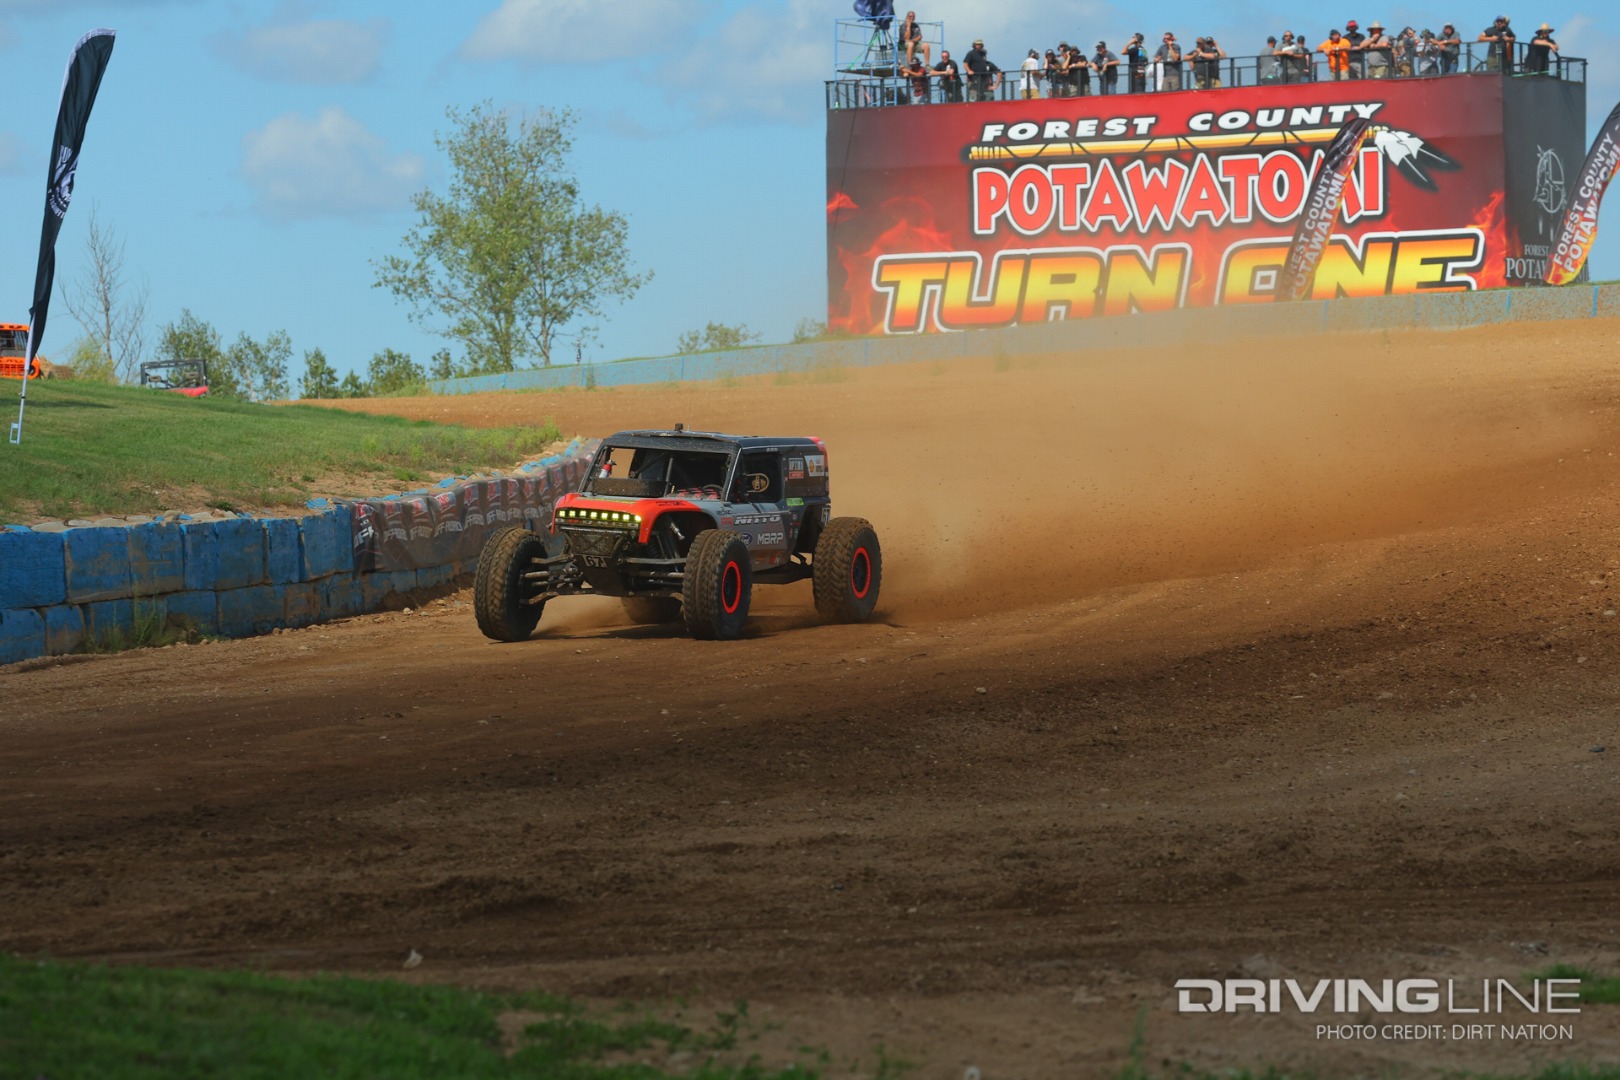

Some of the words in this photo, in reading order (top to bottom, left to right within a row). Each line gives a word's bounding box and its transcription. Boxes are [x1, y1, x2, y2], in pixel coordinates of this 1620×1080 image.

[982, 116, 1158, 142] FOREST
[1188, 103, 1384, 131] COUNTY
[1304, 164, 1334, 231] COUNTY
[1553, 200, 1585, 266] FOREST
[1579, 132, 1614, 199] COUNTY
[1524, 244, 1550, 256] FOREST
[871, 242, 1192, 335] TURN
[1214, 228, 1486, 305] ONE
[734, 514, 781, 525] NITTO
[757, 532, 784, 546] MBRP
